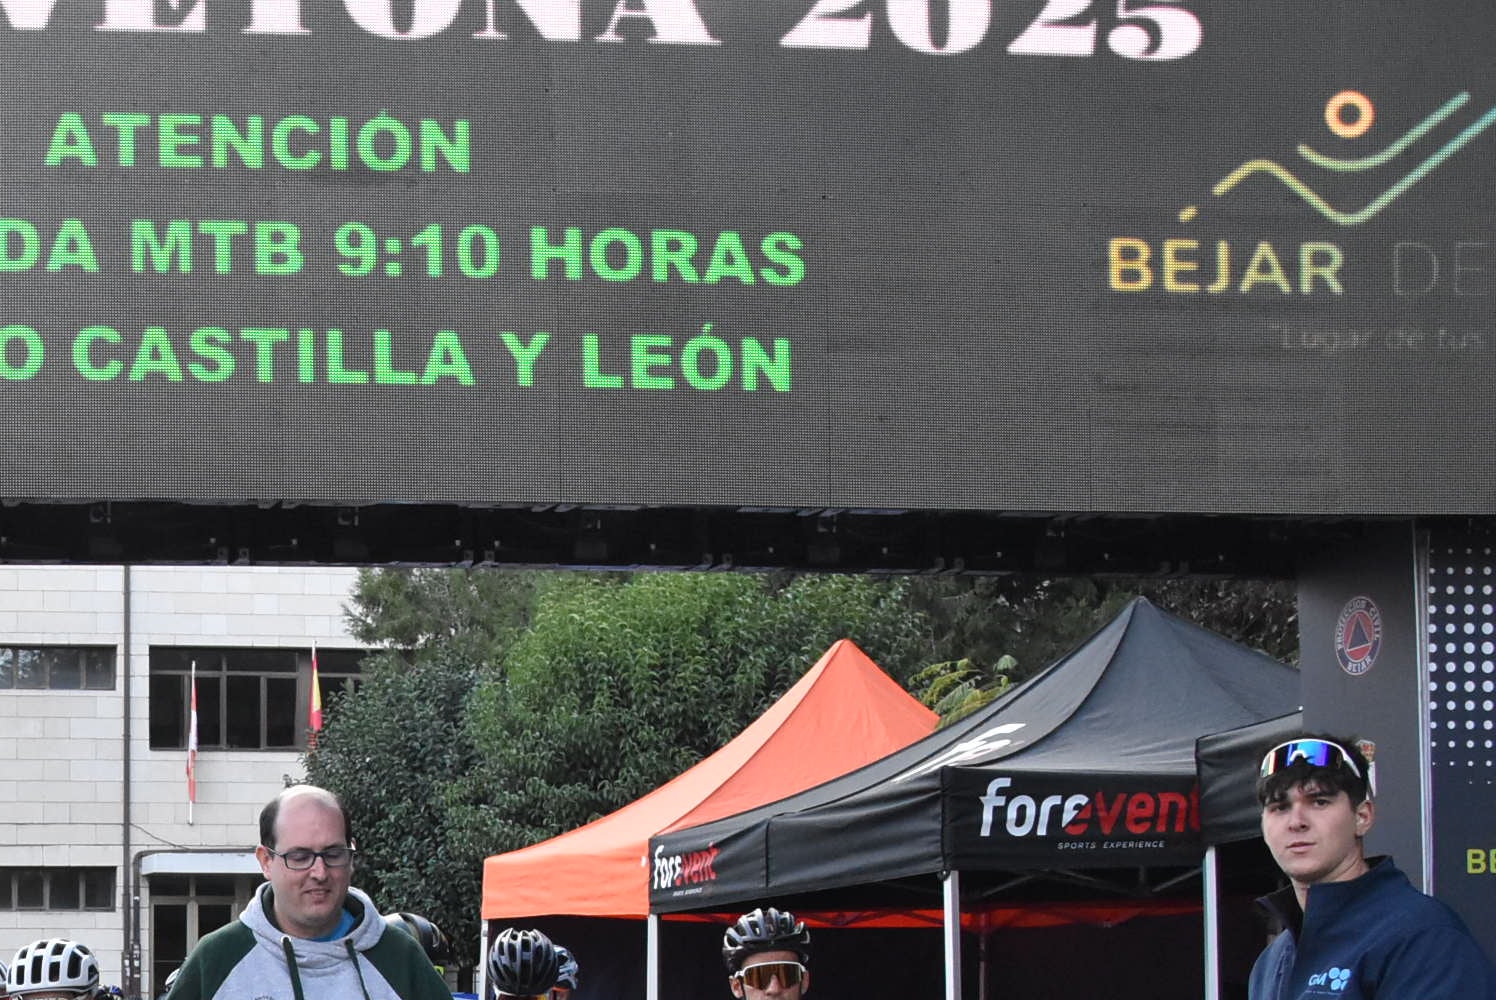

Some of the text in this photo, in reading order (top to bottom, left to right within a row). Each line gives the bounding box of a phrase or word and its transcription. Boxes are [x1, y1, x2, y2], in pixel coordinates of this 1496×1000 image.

[45, 111, 470, 172] ATENCIÓN
[131, 219, 304, 276] MTB
[334, 222, 500, 280] 9:10
[530, 226, 806, 287] HORAS
[1108, 206, 1344, 295] BÉJAR
[71, 325, 476, 386] CASTILLA
[501, 333, 550, 387] Y
[582, 323, 793, 392] LEÓN
[1057, 839, 1166, 850] SPORTS EXPERIENCE
